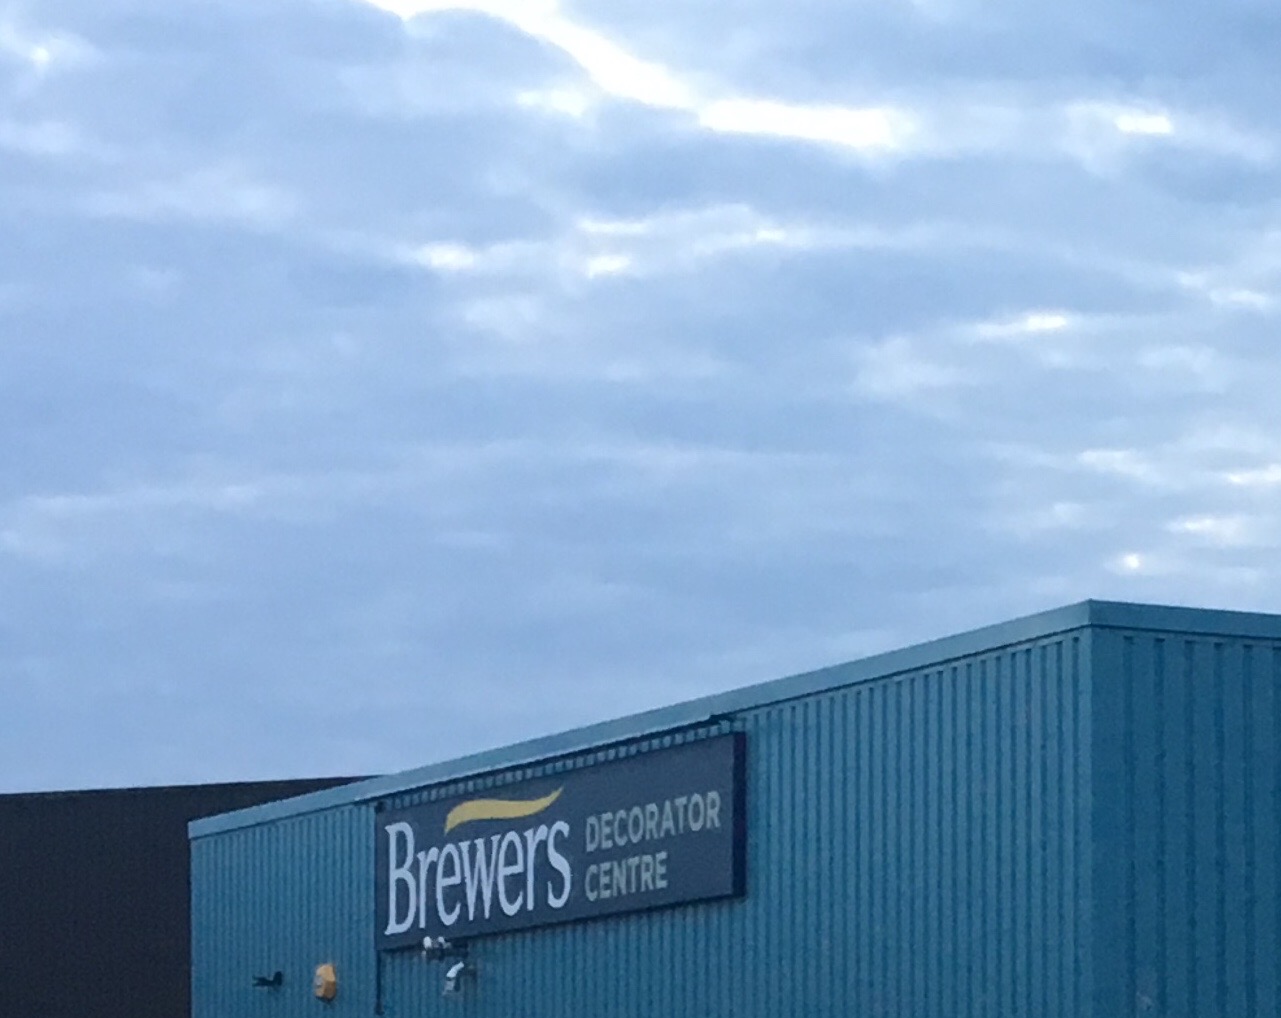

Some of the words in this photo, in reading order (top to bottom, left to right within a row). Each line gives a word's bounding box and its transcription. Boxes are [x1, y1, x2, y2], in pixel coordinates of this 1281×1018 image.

[585, 790, 722, 853] DECORATOR
[384, 821, 572, 936] Brewers
[584, 851, 668, 902] CENTRE
